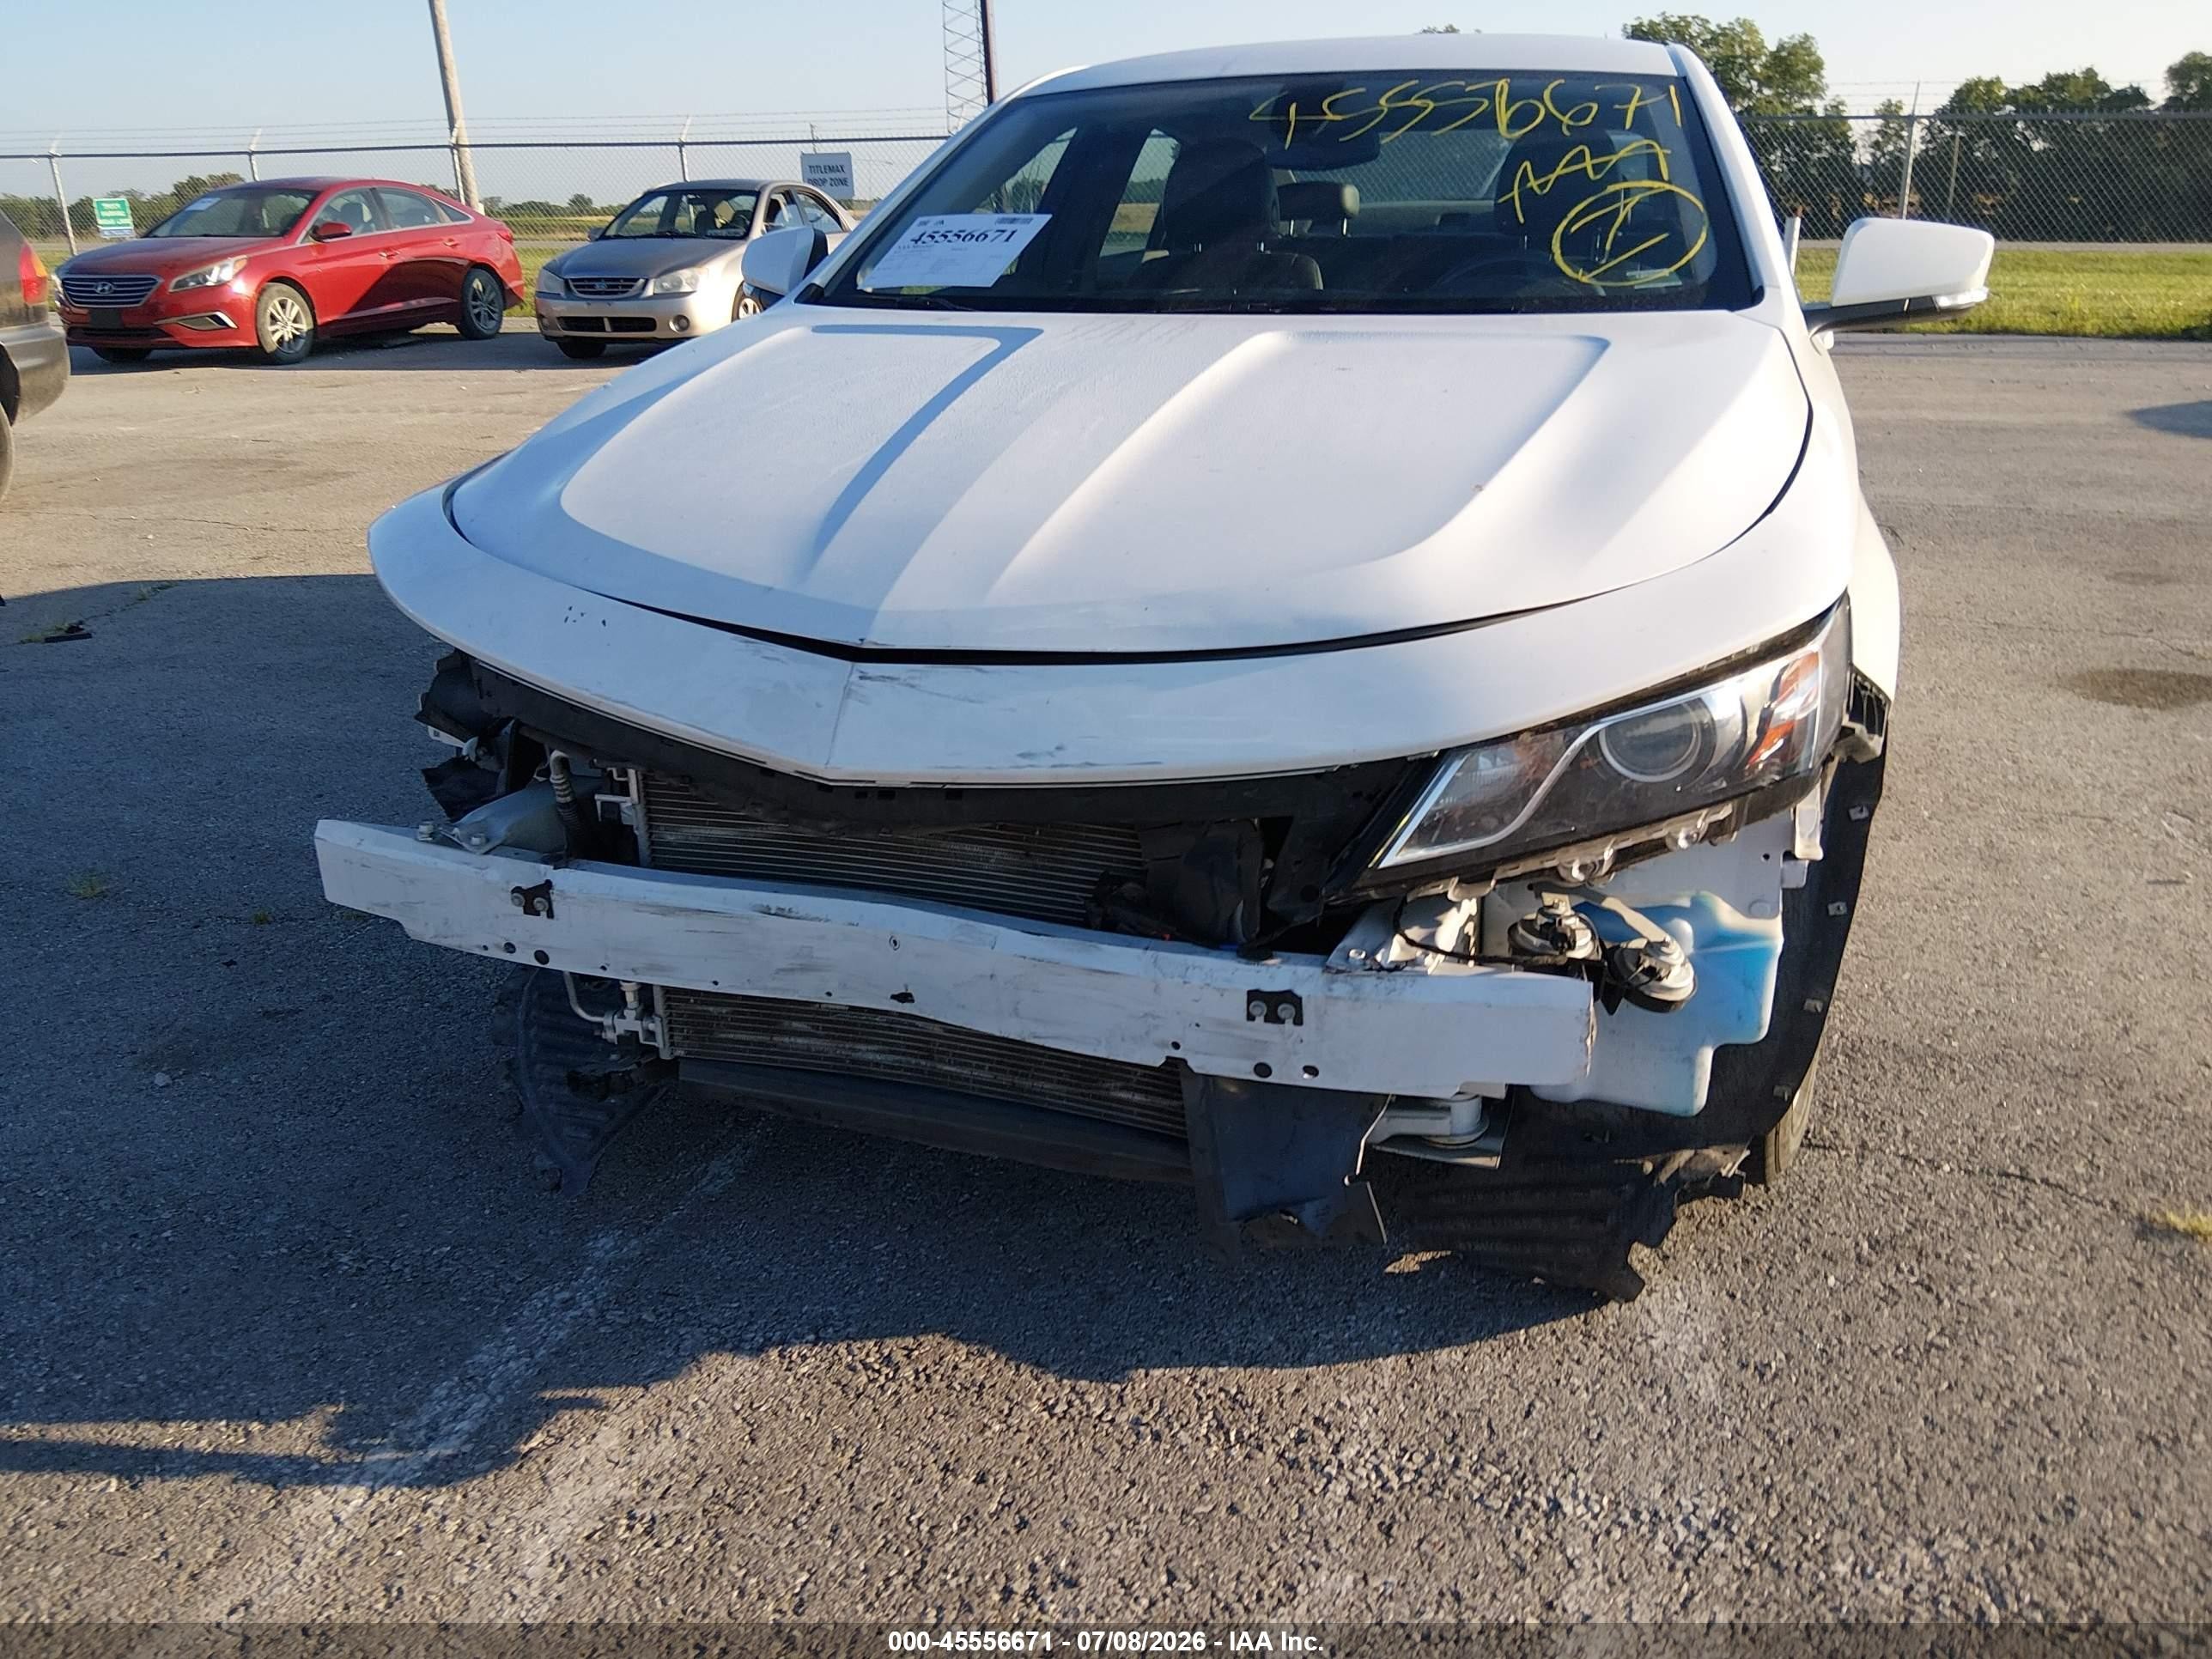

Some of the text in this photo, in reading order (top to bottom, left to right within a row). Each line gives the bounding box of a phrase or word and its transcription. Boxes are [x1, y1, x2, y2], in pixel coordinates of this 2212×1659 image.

[1249, 78, 1682, 150] 45556671
[808, 164, 845, 174] TITLEMAX
[807, 177, 849, 187] DROP ZONE
[910, 228, 1018, 245] 45556671
